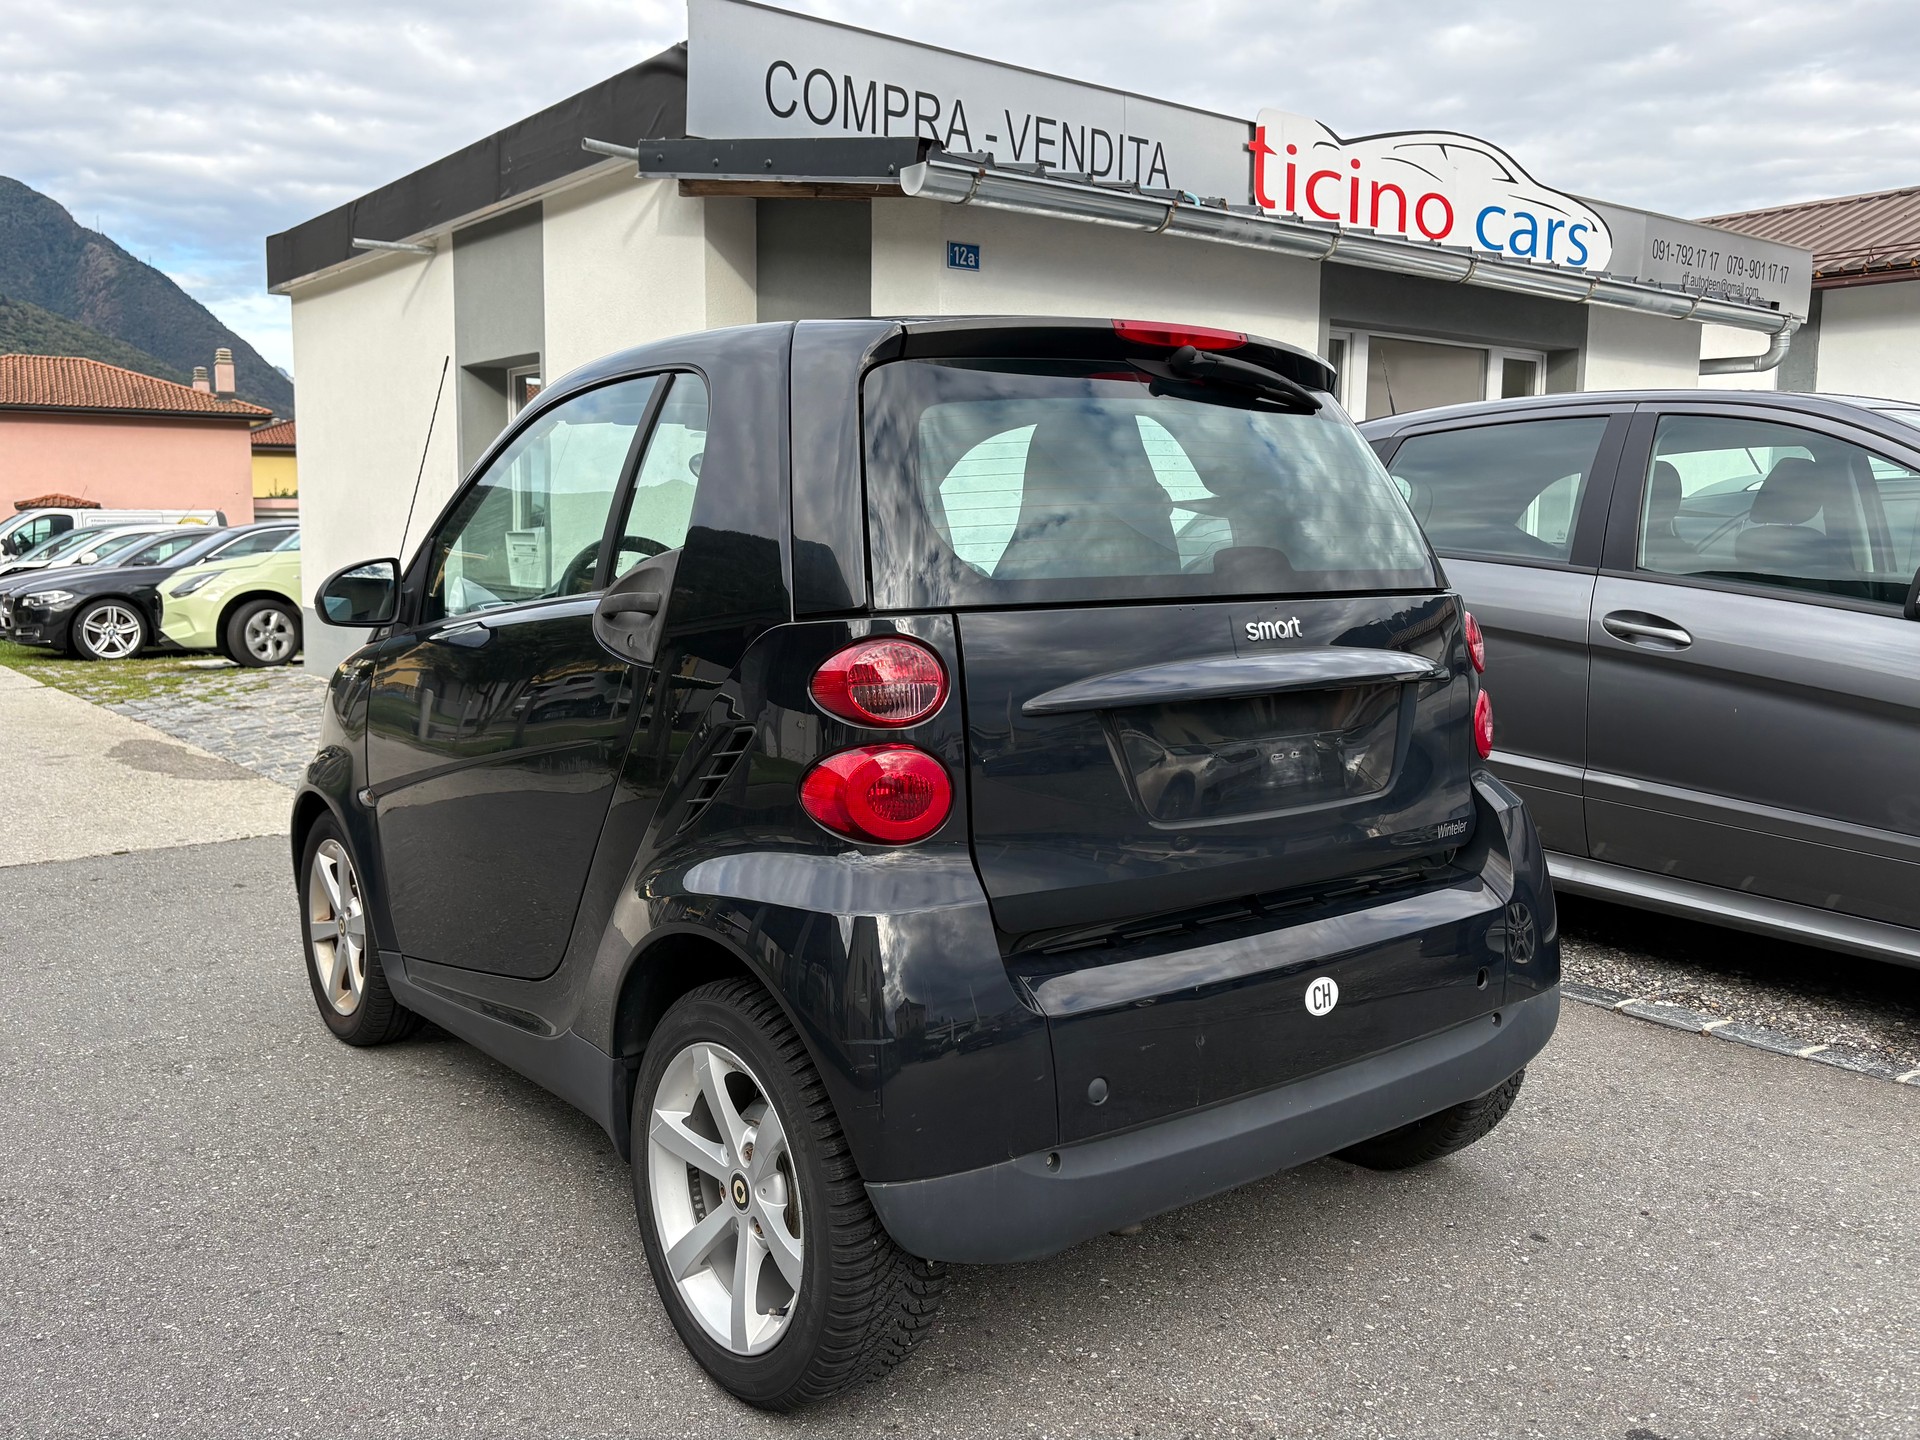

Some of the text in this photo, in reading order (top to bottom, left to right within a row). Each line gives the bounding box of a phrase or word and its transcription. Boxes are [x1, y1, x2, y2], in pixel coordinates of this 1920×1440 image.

[765, 60, 973, 153] COMPRA
[1004, 109, 1170, 189] VENDITA
[1248, 125, 1589, 266] ticino cars
[953, 246, 976, 267] 12a
[1652, 238, 1790, 285] 091-792 17 17 079-901 17 17
[1245, 616, 1303, 642] smart
[1437, 819, 1468, 839] Winteler
[1313, 982, 1332, 1010] CH
